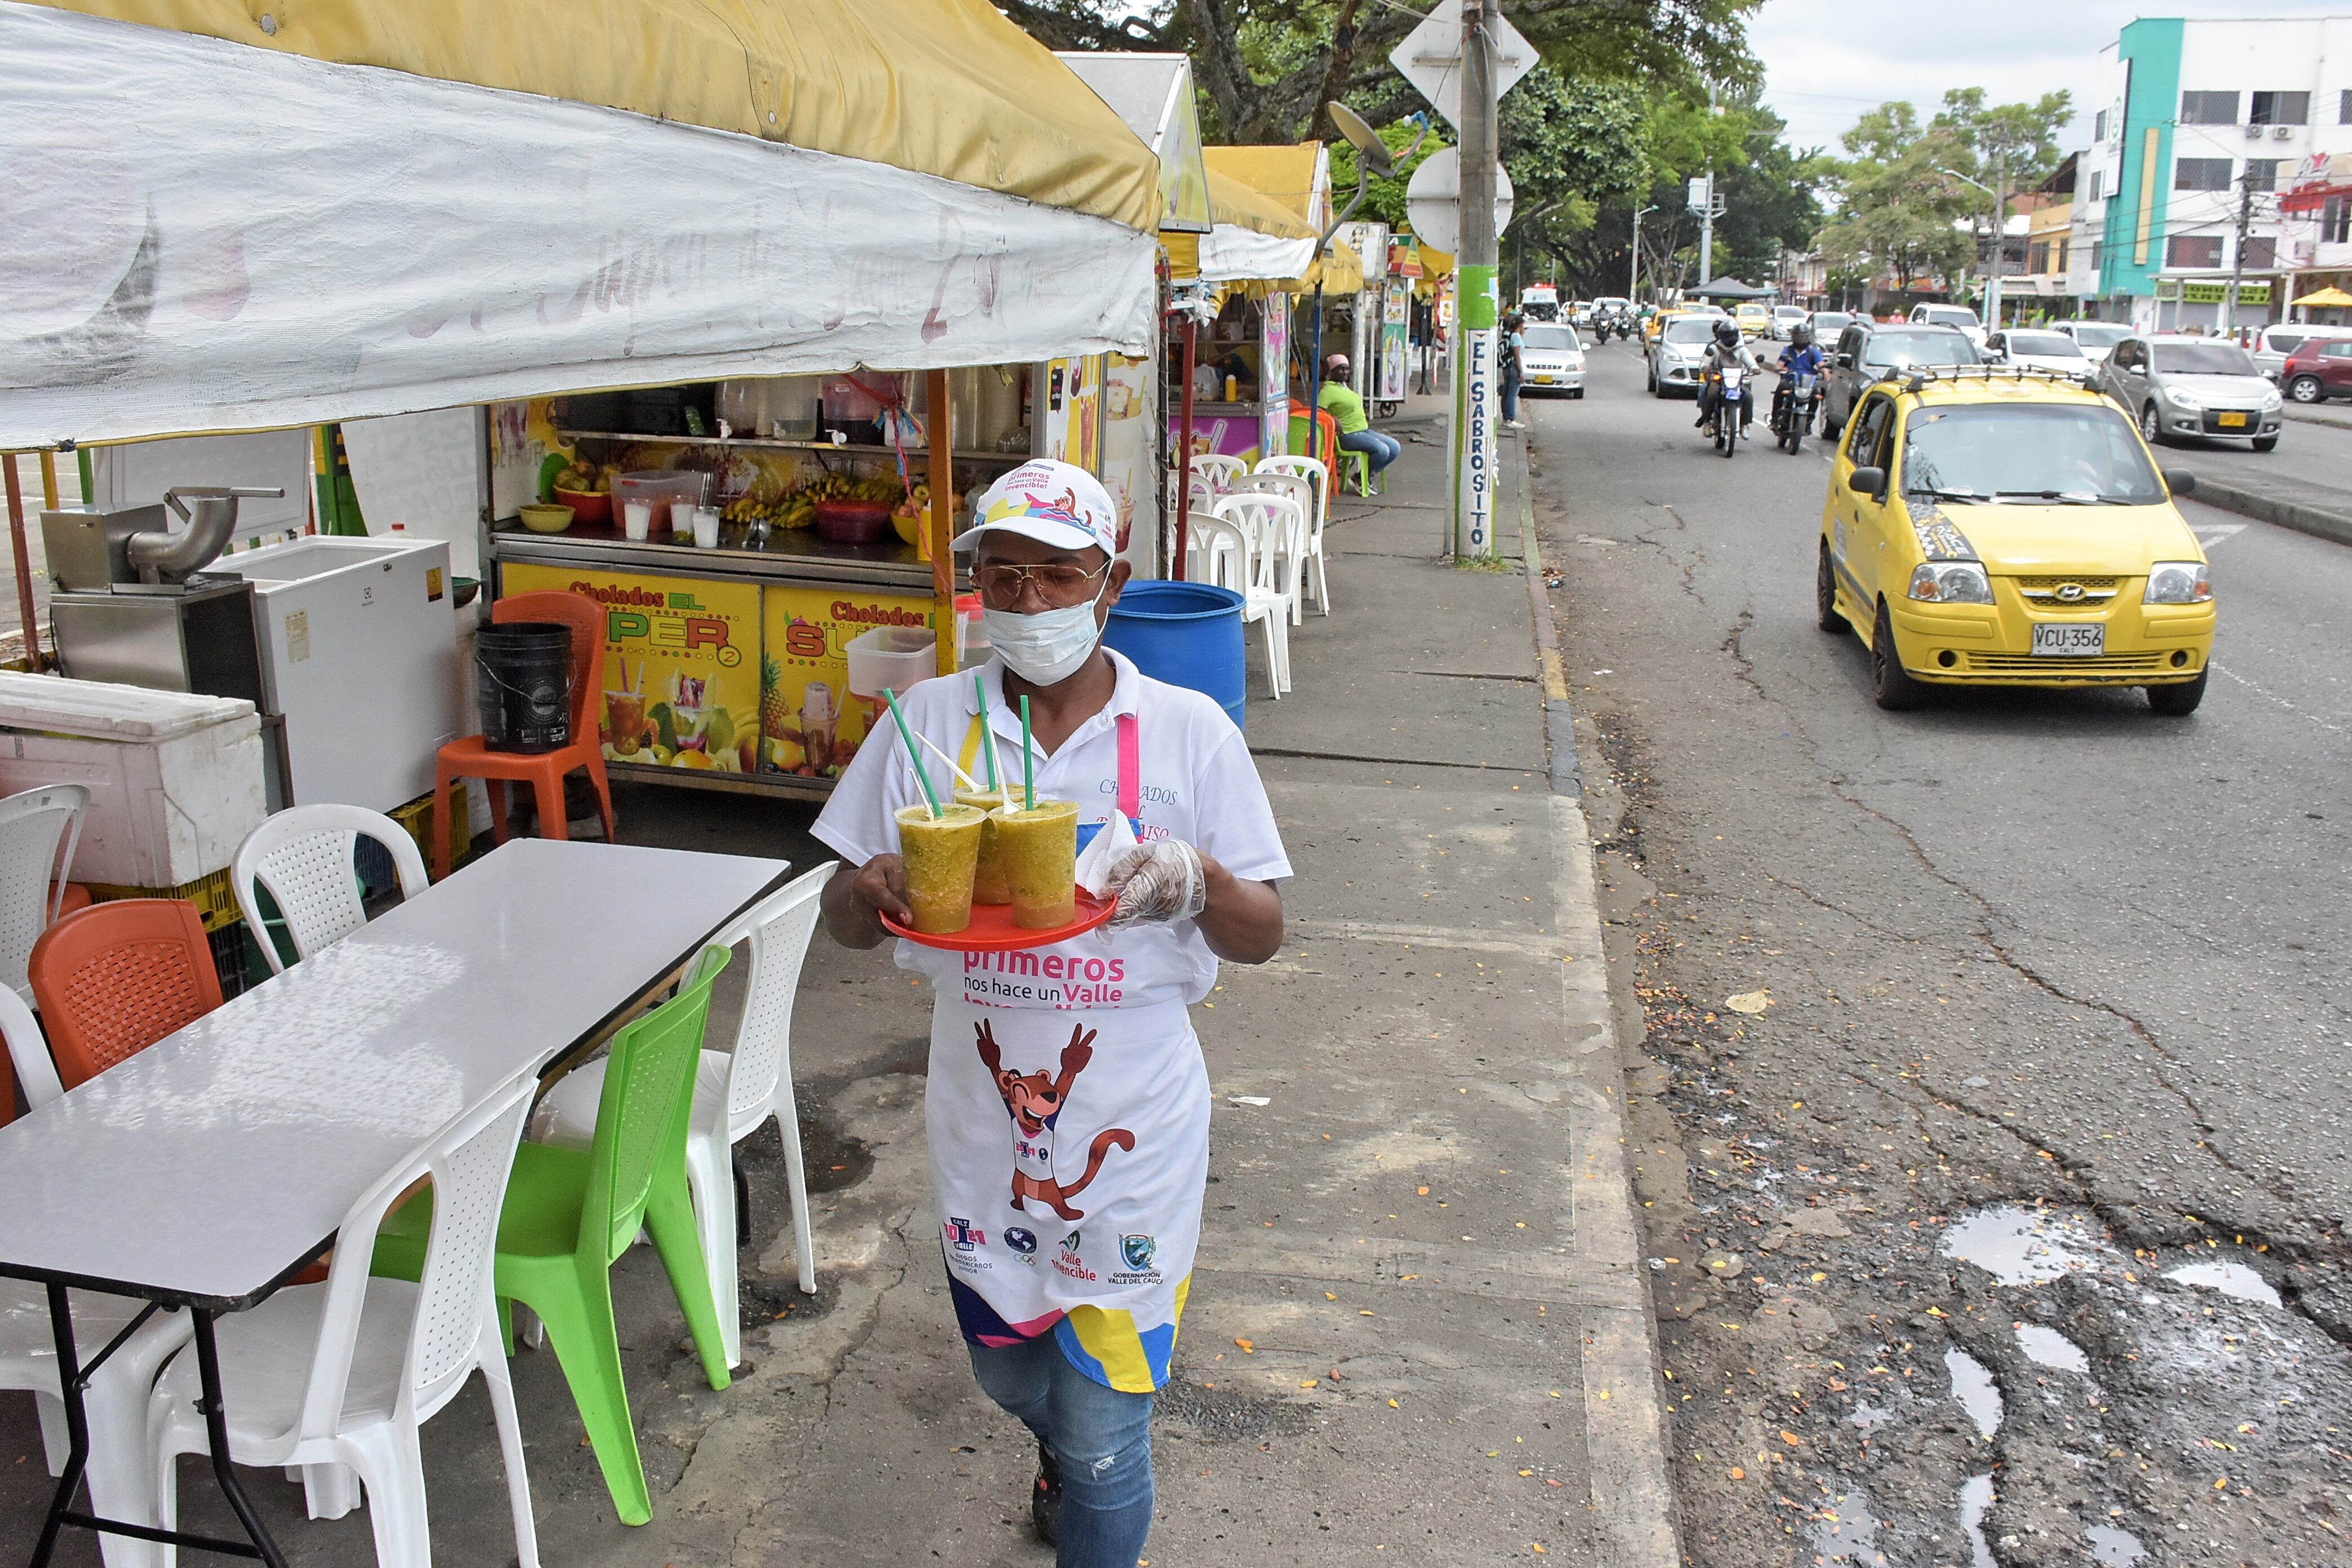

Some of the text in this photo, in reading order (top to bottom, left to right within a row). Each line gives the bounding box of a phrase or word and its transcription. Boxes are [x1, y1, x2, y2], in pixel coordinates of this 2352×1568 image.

[1471, 342, 1486, 545] EL SABROSITO
[1005, 482, 1047, 491] invencible!
[1008, 472, 1050, 483] primeros
[669, 592, 706, 610] EL
[830, 600, 925, 626] Cholados
[608, 611, 729, 650] PER
[1100, 779, 1178, 805] CHADOS
[964, 951, 1124, 982] primeros
[965, 977, 988, 992] nos
[993, 978, 1032, 999] hace
[1038, 989, 1060, 1001] un
[1063, 984, 1122, 1002] Valle
[1062, 1250, 1081, 1266] Valle
